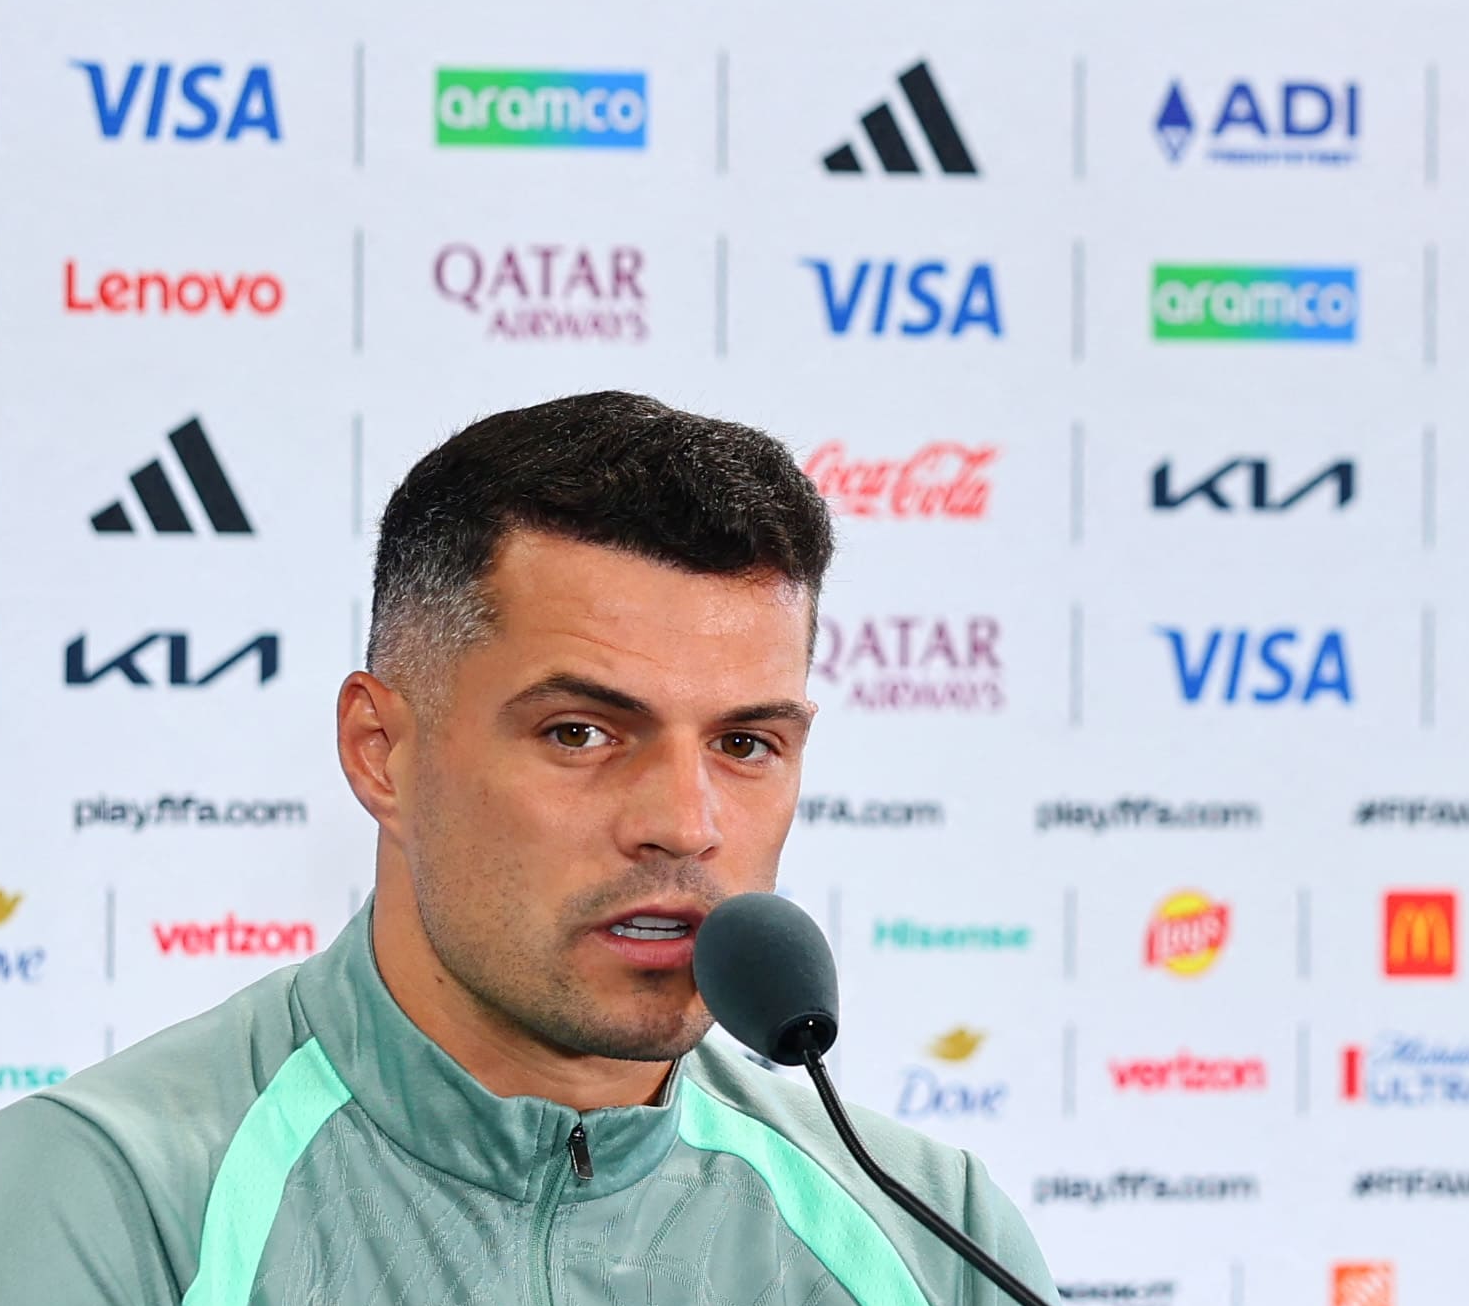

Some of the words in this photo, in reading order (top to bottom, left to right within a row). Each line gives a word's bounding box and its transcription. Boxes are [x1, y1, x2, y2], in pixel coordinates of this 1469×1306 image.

[75, 61, 282, 143] VISA
[436, 86, 645, 132] aramco
[1211, 80, 1360, 140] ADI
[63, 260, 284, 316] Lenovo
[432, 245, 645, 317] QATAR
[807, 259, 1004, 338] VISA
[1152, 275, 1355, 326] aramco
[816, 615, 1003, 683] QATAR
[1163, 628, 1354, 705] VISA
[73, 794, 307, 832] play.fifa.com
[152, 912, 318, 958] verizon
[873, 919, 1032, 951] Hisense
[1109, 1054, 1266, 1092] verizon
